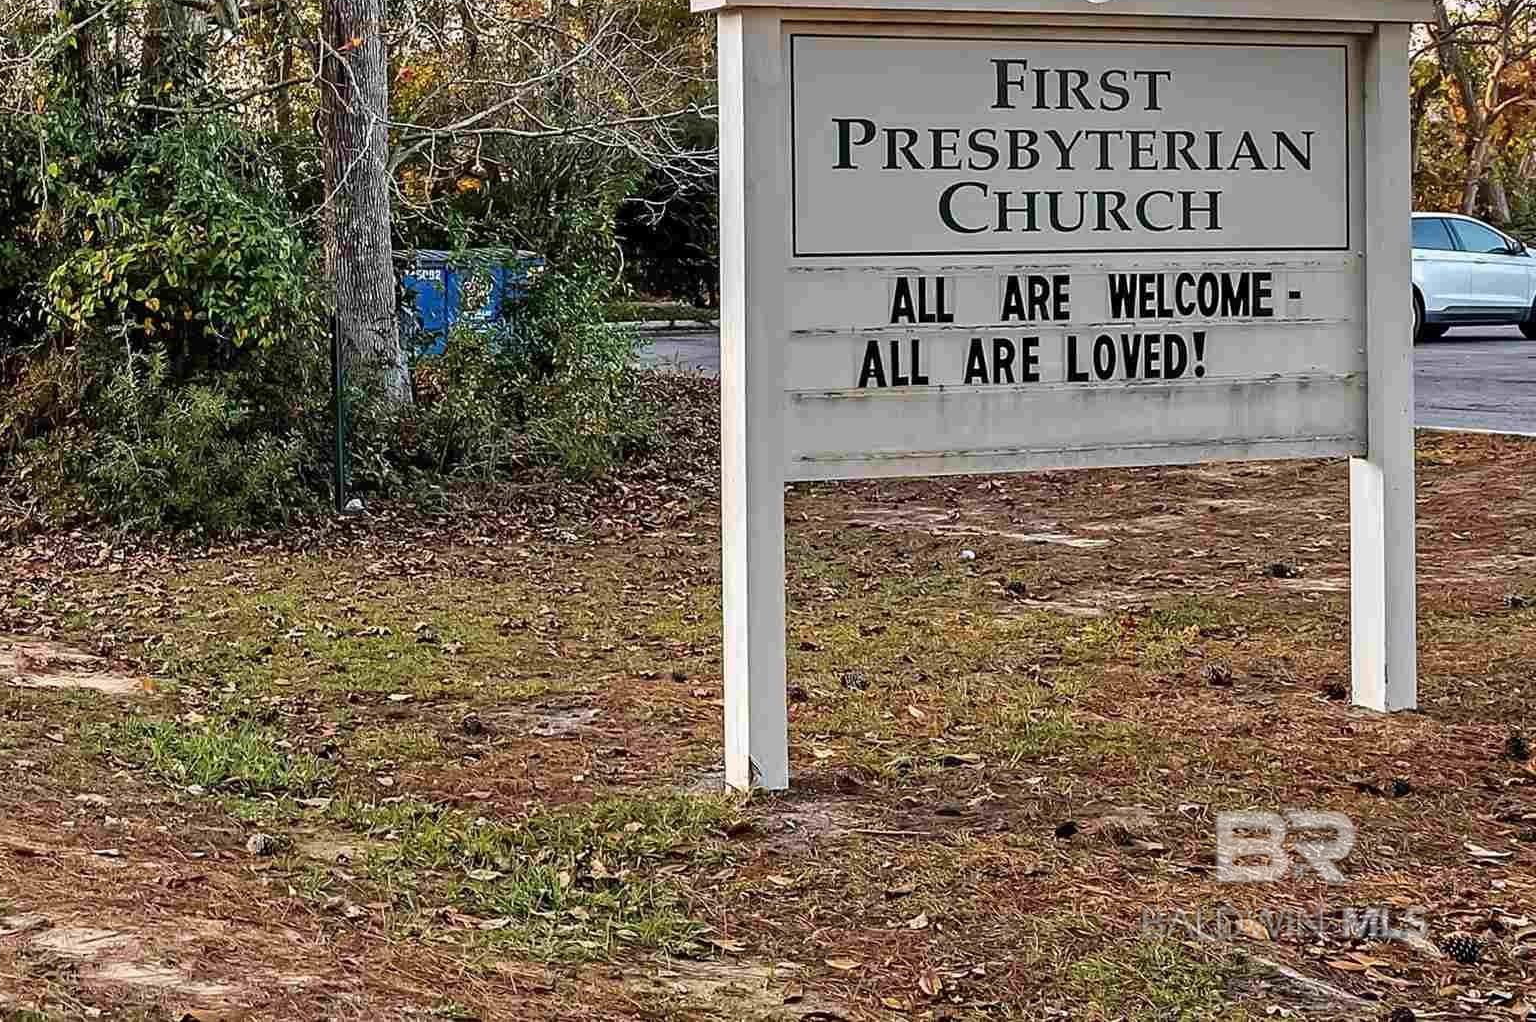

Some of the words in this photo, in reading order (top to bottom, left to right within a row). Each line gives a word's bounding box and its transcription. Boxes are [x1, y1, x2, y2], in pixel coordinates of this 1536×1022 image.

[990, 58, 1171, 112] FIRST
[831, 117, 1316, 171] PRESBYTERIAN
[938, 181, 1223, 234] CHURCH
[890, 276, 954, 324] ALL
[1001, 274, 1070, 321] ARE
[1108, 271, 1275, 319] WELCOME
[857, 339, 929, 388] ALL
[964, 335, 1040, 385] ARE
[1066, 330, 1208, 383] LOVED!
